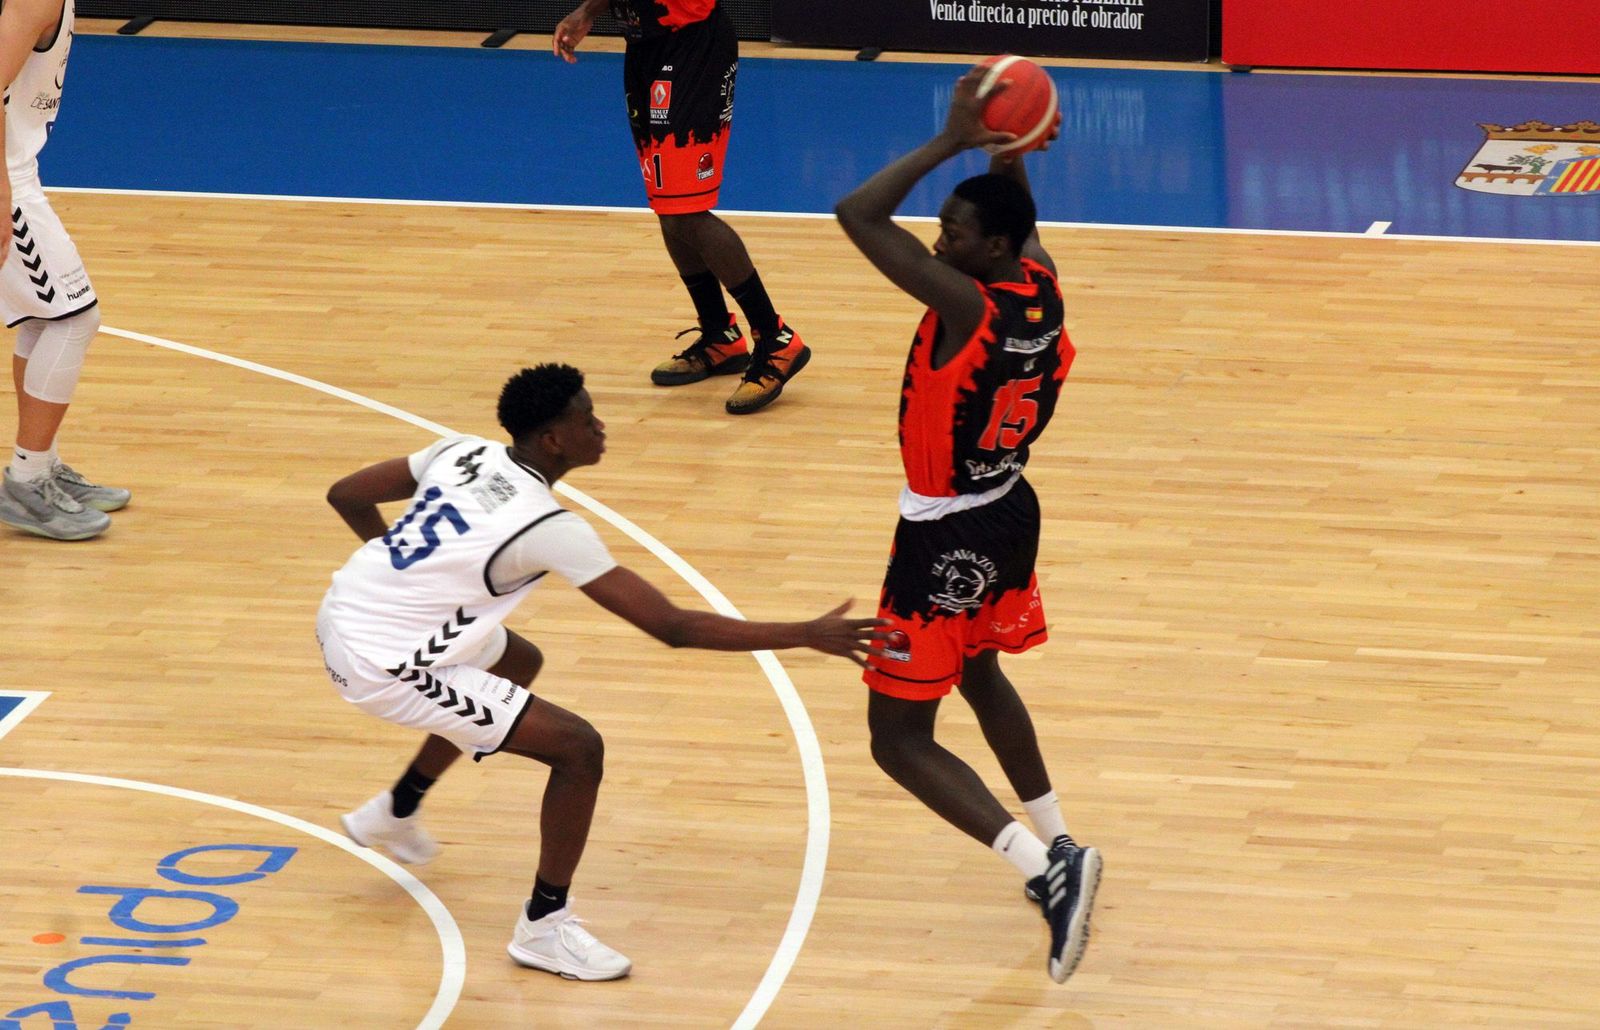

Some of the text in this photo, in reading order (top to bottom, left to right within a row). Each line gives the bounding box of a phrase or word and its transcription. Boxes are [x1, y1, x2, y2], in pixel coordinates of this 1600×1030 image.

[928, 0, 1144, 30] Venta directa a precio de obrador
[653, 153, 663, 190] 1
[724, 328, 739, 341] N
[777, 331, 793, 344] N
[977, 373, 1043, 451] 15
